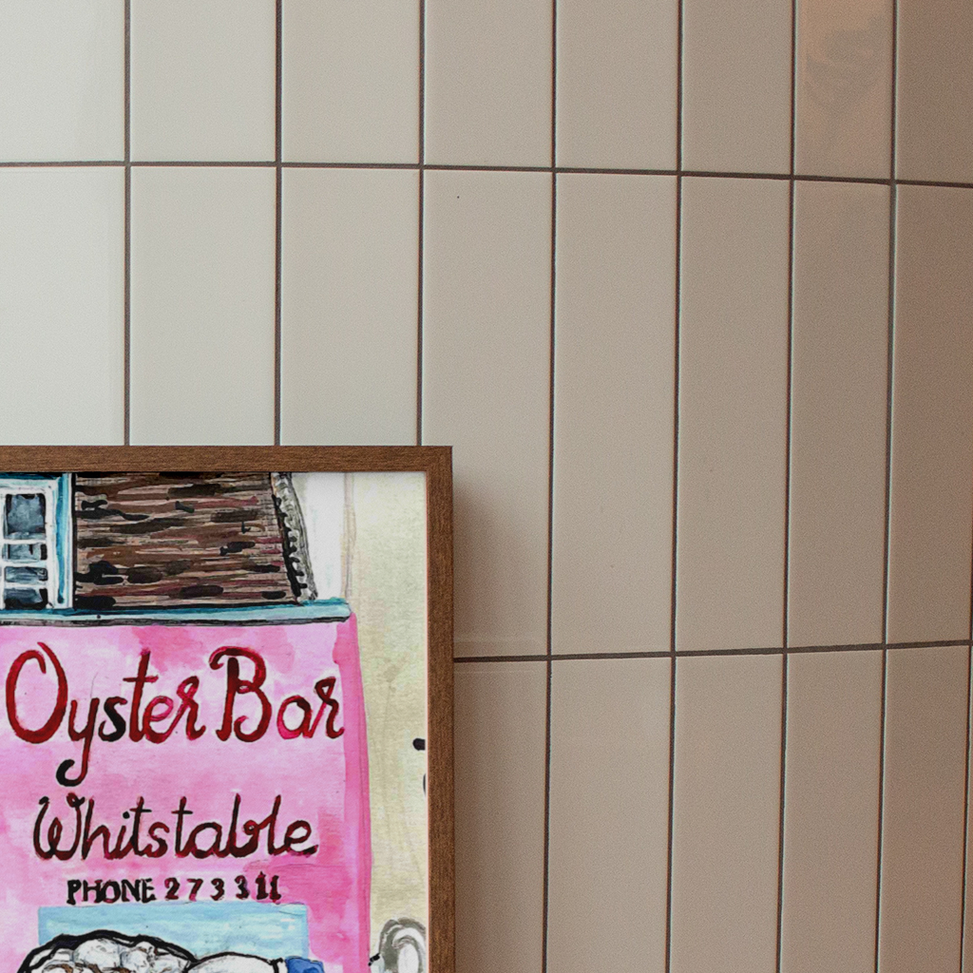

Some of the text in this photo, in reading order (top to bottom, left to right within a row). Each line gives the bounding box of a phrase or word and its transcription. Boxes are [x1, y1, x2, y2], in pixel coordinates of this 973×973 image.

[5, 640, 207, 787] Oyster
[209, 645, 345, 742] Bar
[32, 793, 319, 861] Whitstable
[66, 877, 157, 905] PHONE
